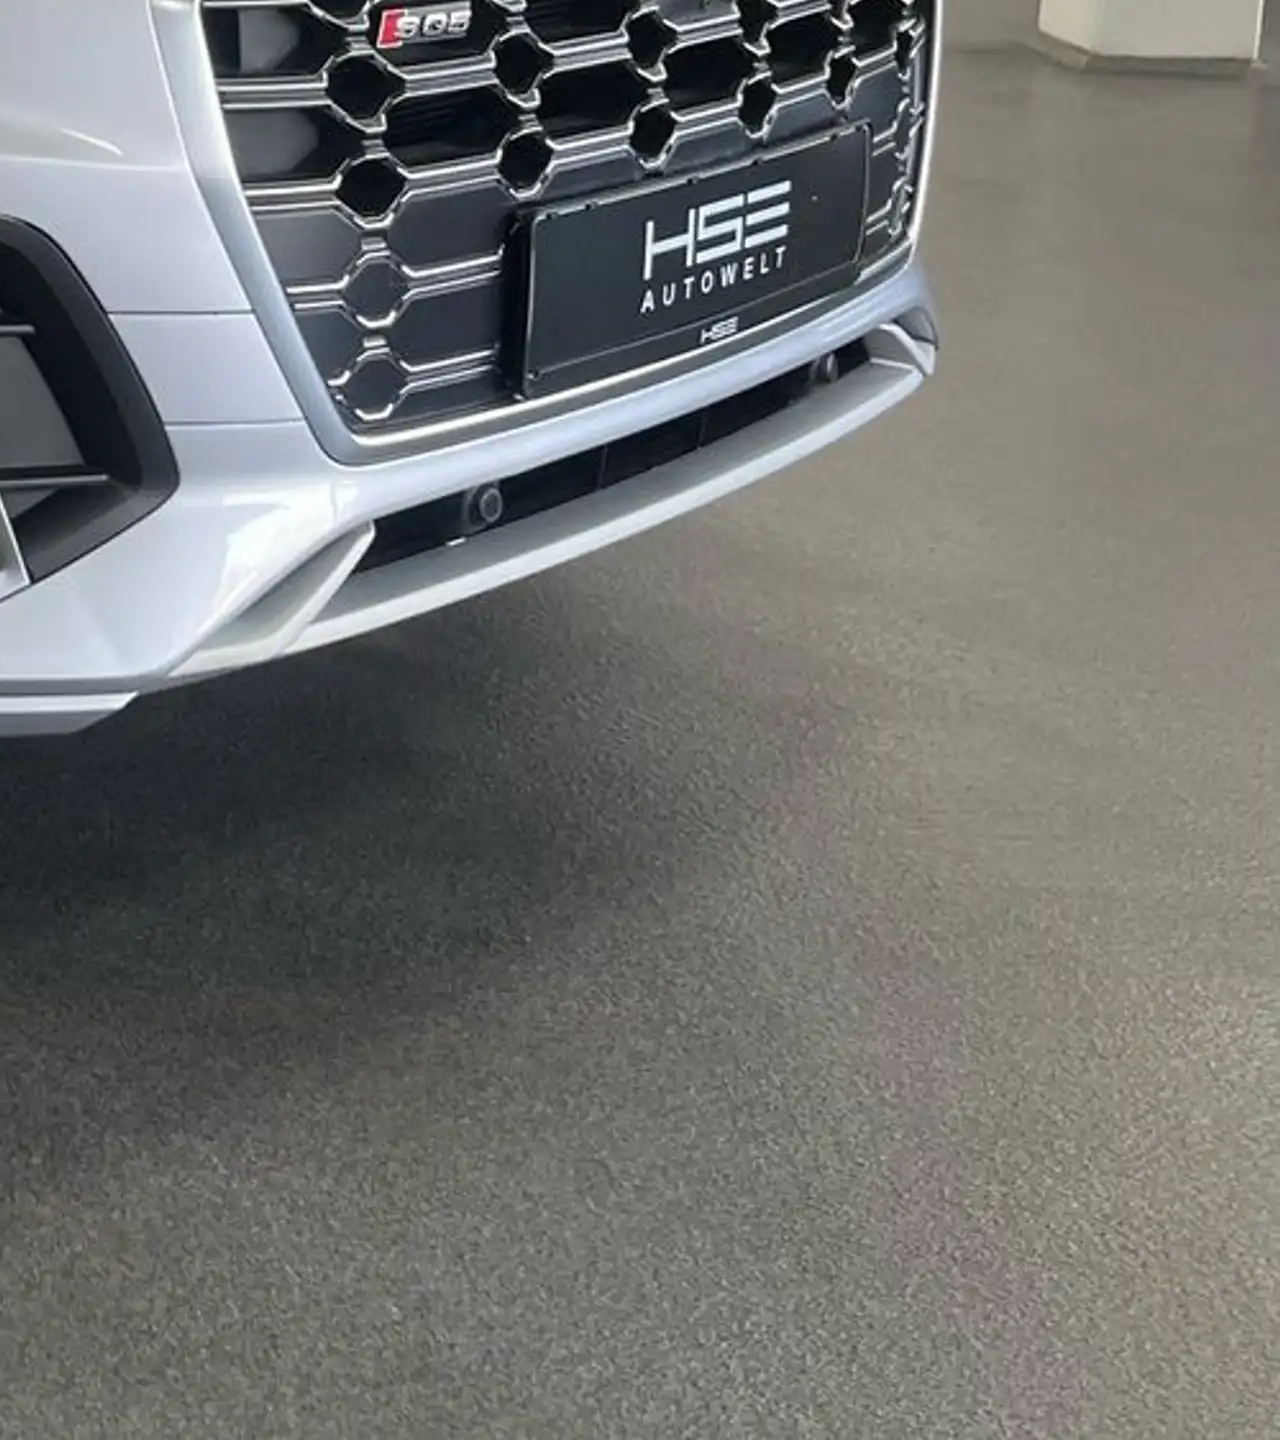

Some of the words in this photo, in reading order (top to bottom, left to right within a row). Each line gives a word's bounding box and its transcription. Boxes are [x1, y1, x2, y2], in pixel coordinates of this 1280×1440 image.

[392, 9, 472, 39] SQ5
[643, 180, 792, 281] HSE
[640, 246, 786, 313] AUTOWELT
